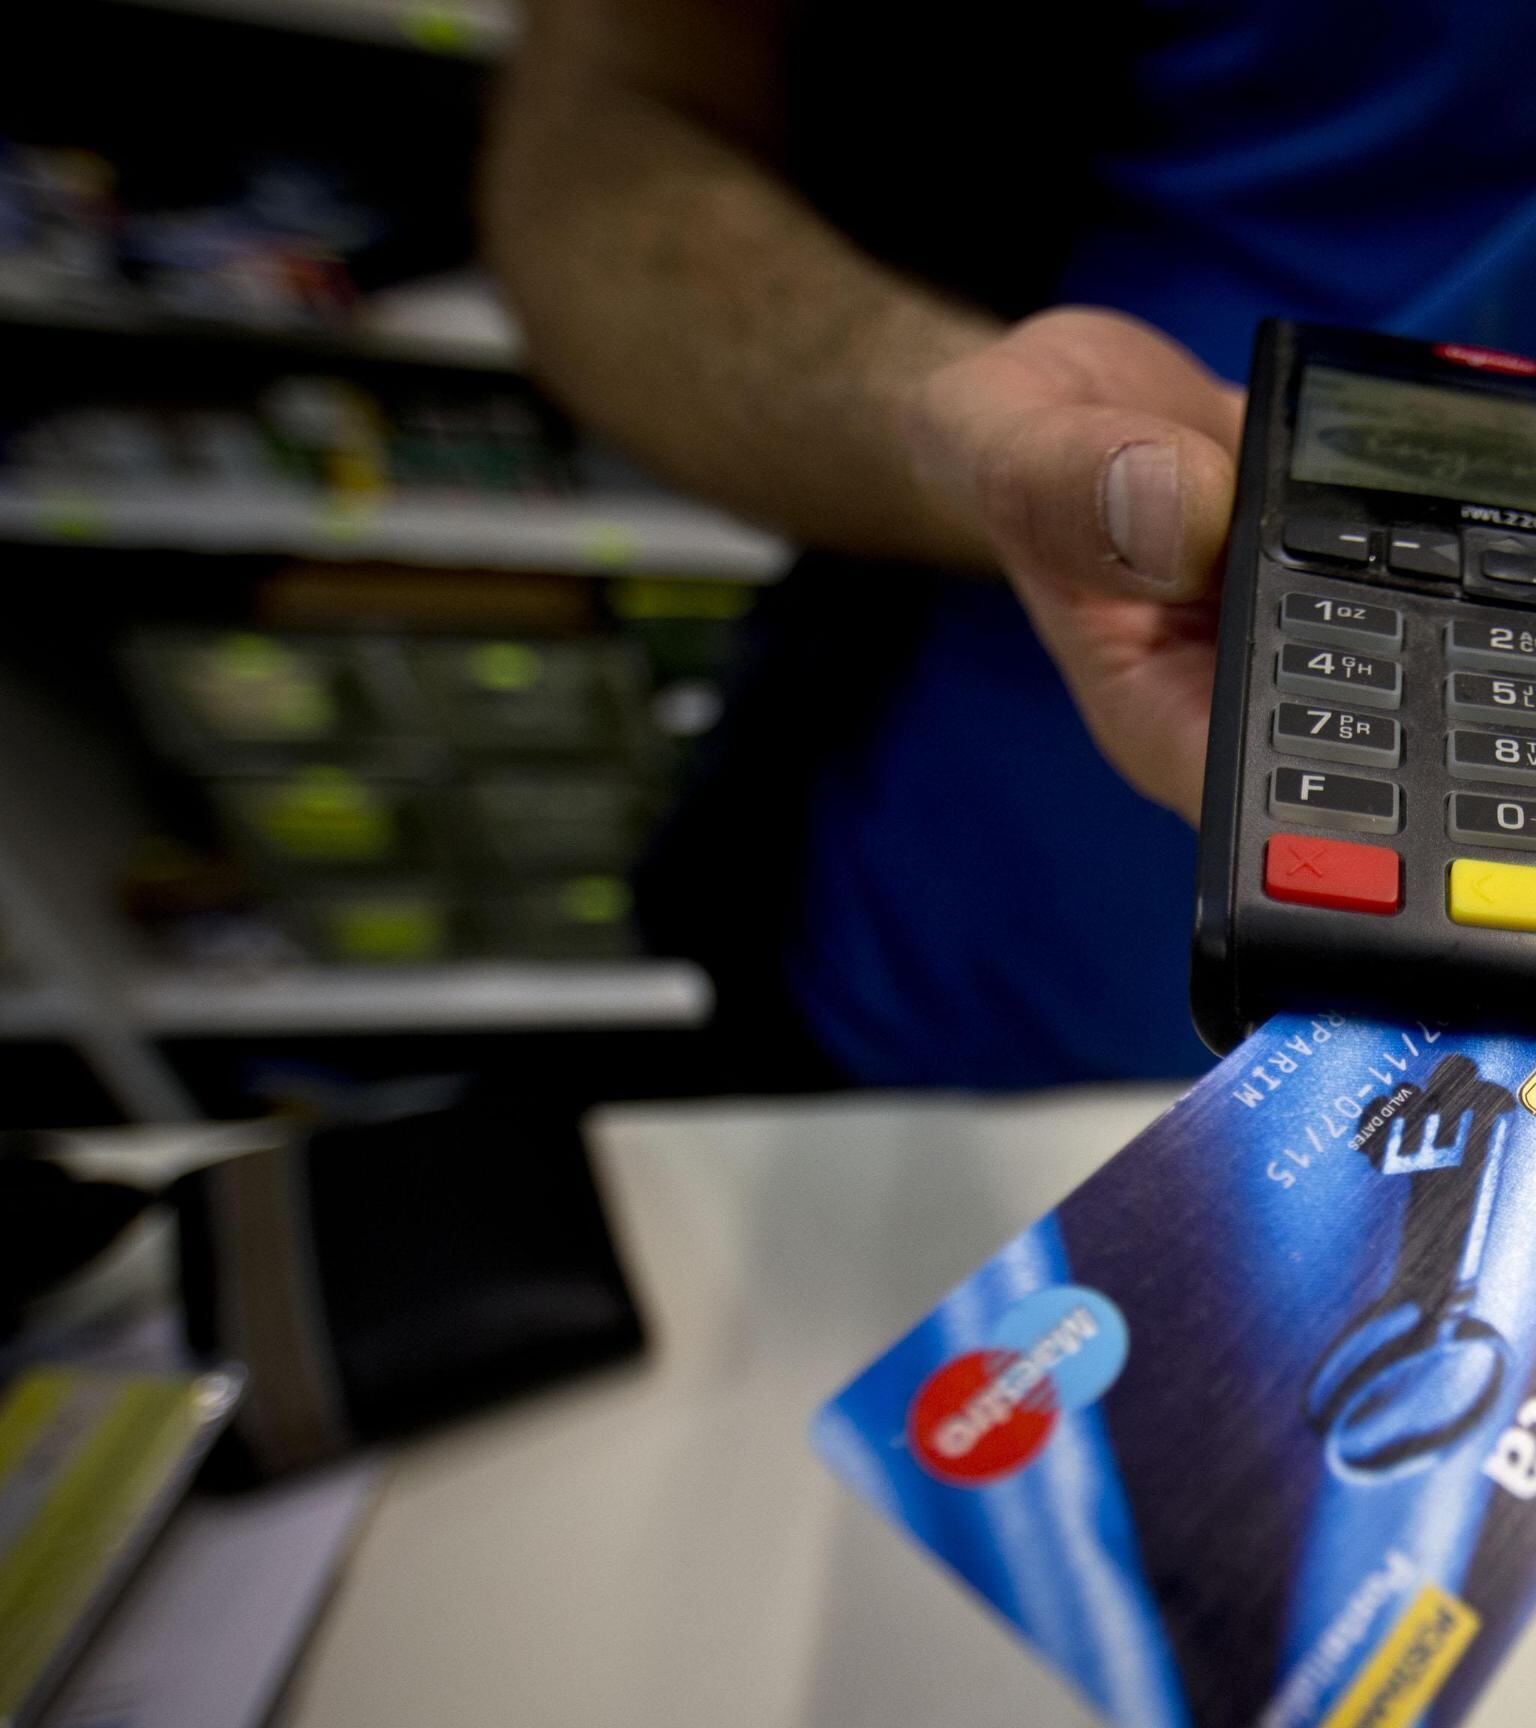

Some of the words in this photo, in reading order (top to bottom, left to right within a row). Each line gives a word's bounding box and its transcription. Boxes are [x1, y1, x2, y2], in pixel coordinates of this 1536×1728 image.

[1315, 601, 1333, 621] 1
[1490, 628, 1515, 650] 2
[1308, 653, 1335, 675] 4
[1492, 681, 1517, 705] 5
[1307, 710, 1332, 735] 7
[1495, 739, 1520, 763] 8
[1301, 774, 1326, 801] F
[1497, 803, 1525, 830] 0
[1267, 1020, 1447, 1189] 7/11-07/15
[1380, 1088, 1413, 1118] VALID
[1347, 1115, 1384, 1151] DATES
